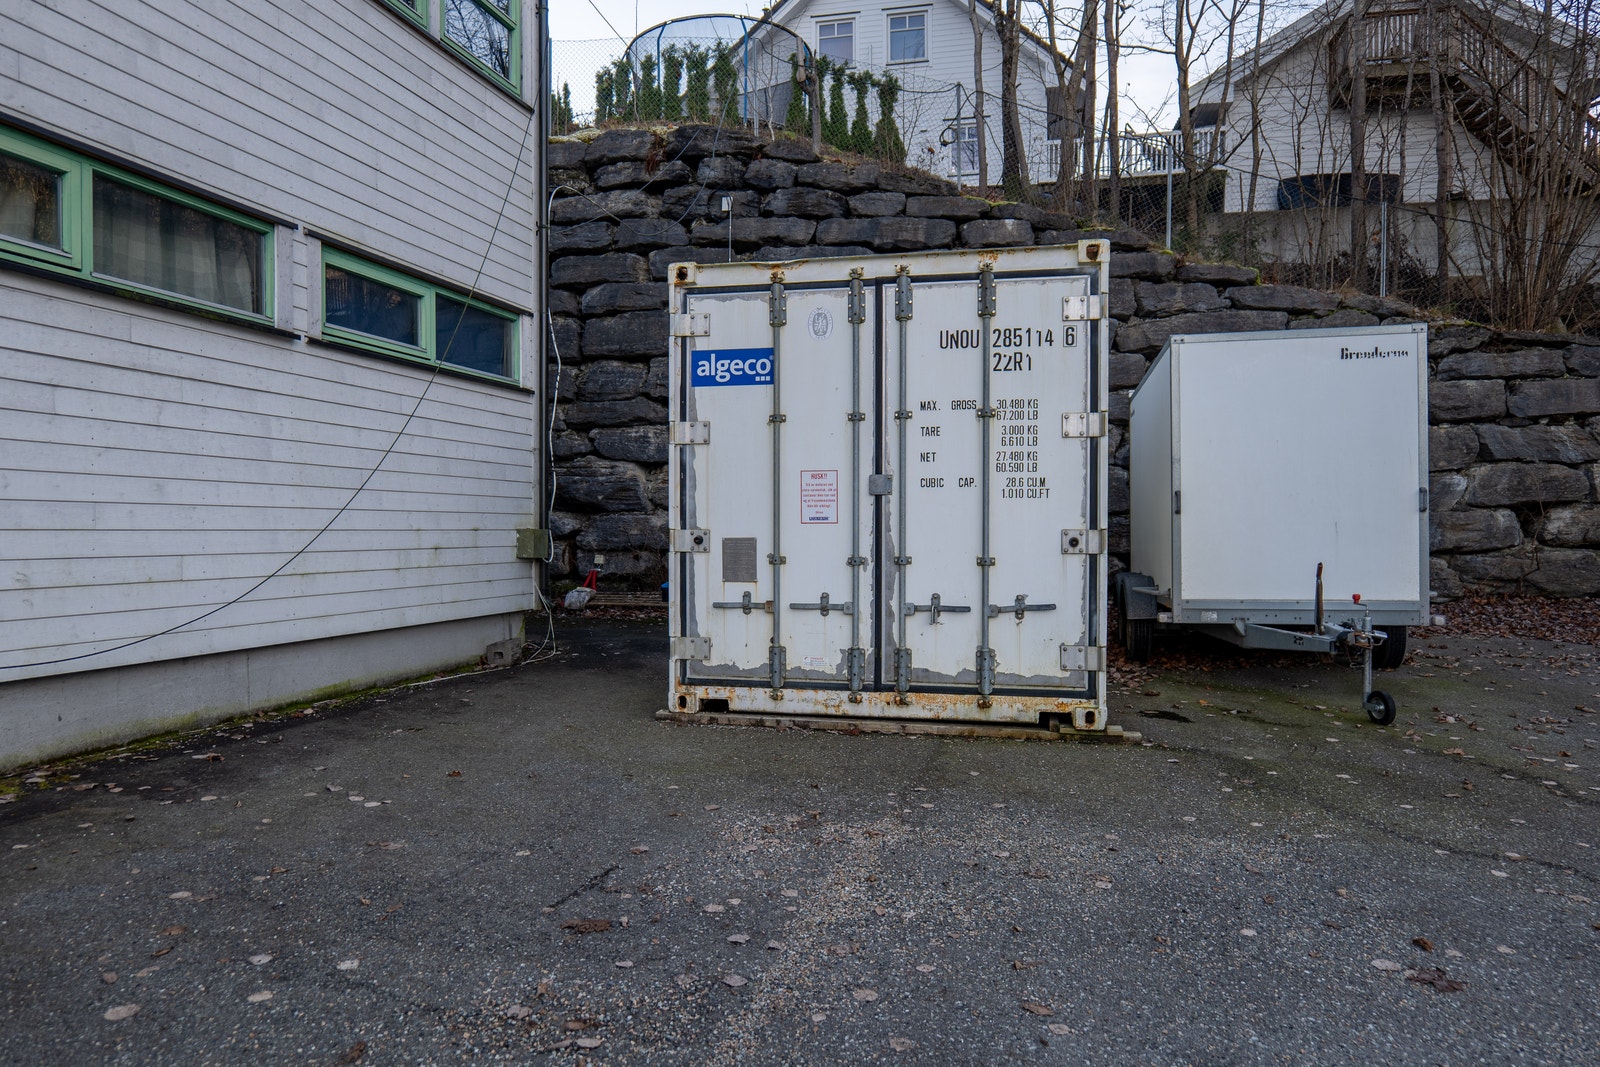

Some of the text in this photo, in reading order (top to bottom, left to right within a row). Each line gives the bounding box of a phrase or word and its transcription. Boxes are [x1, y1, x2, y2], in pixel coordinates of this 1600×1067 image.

[939, 326, 1075, 349] UNOU 285114 6
[992, 351, 1032, 372] 22R1
[696, 353, 772, 383] algeco
[920, 398, 1039, 411] MAX. GROSS 30.480 KG
[996, 410, 1038, 421] 67.200 LB
[920, 424, 1038, 437] TARE 3.000 KG
[1001, 436, 1038, 447] 6.610 LB
[920, 451, 1038, 463] NET 27.480 KG
[995, 462, 1038, 473] 60.590 LB
[920, 477, 1046, 488] CUBIC CAP. 28.6 CU.M
[1001, 488, 1050, 499] 1.010 CU.FT
